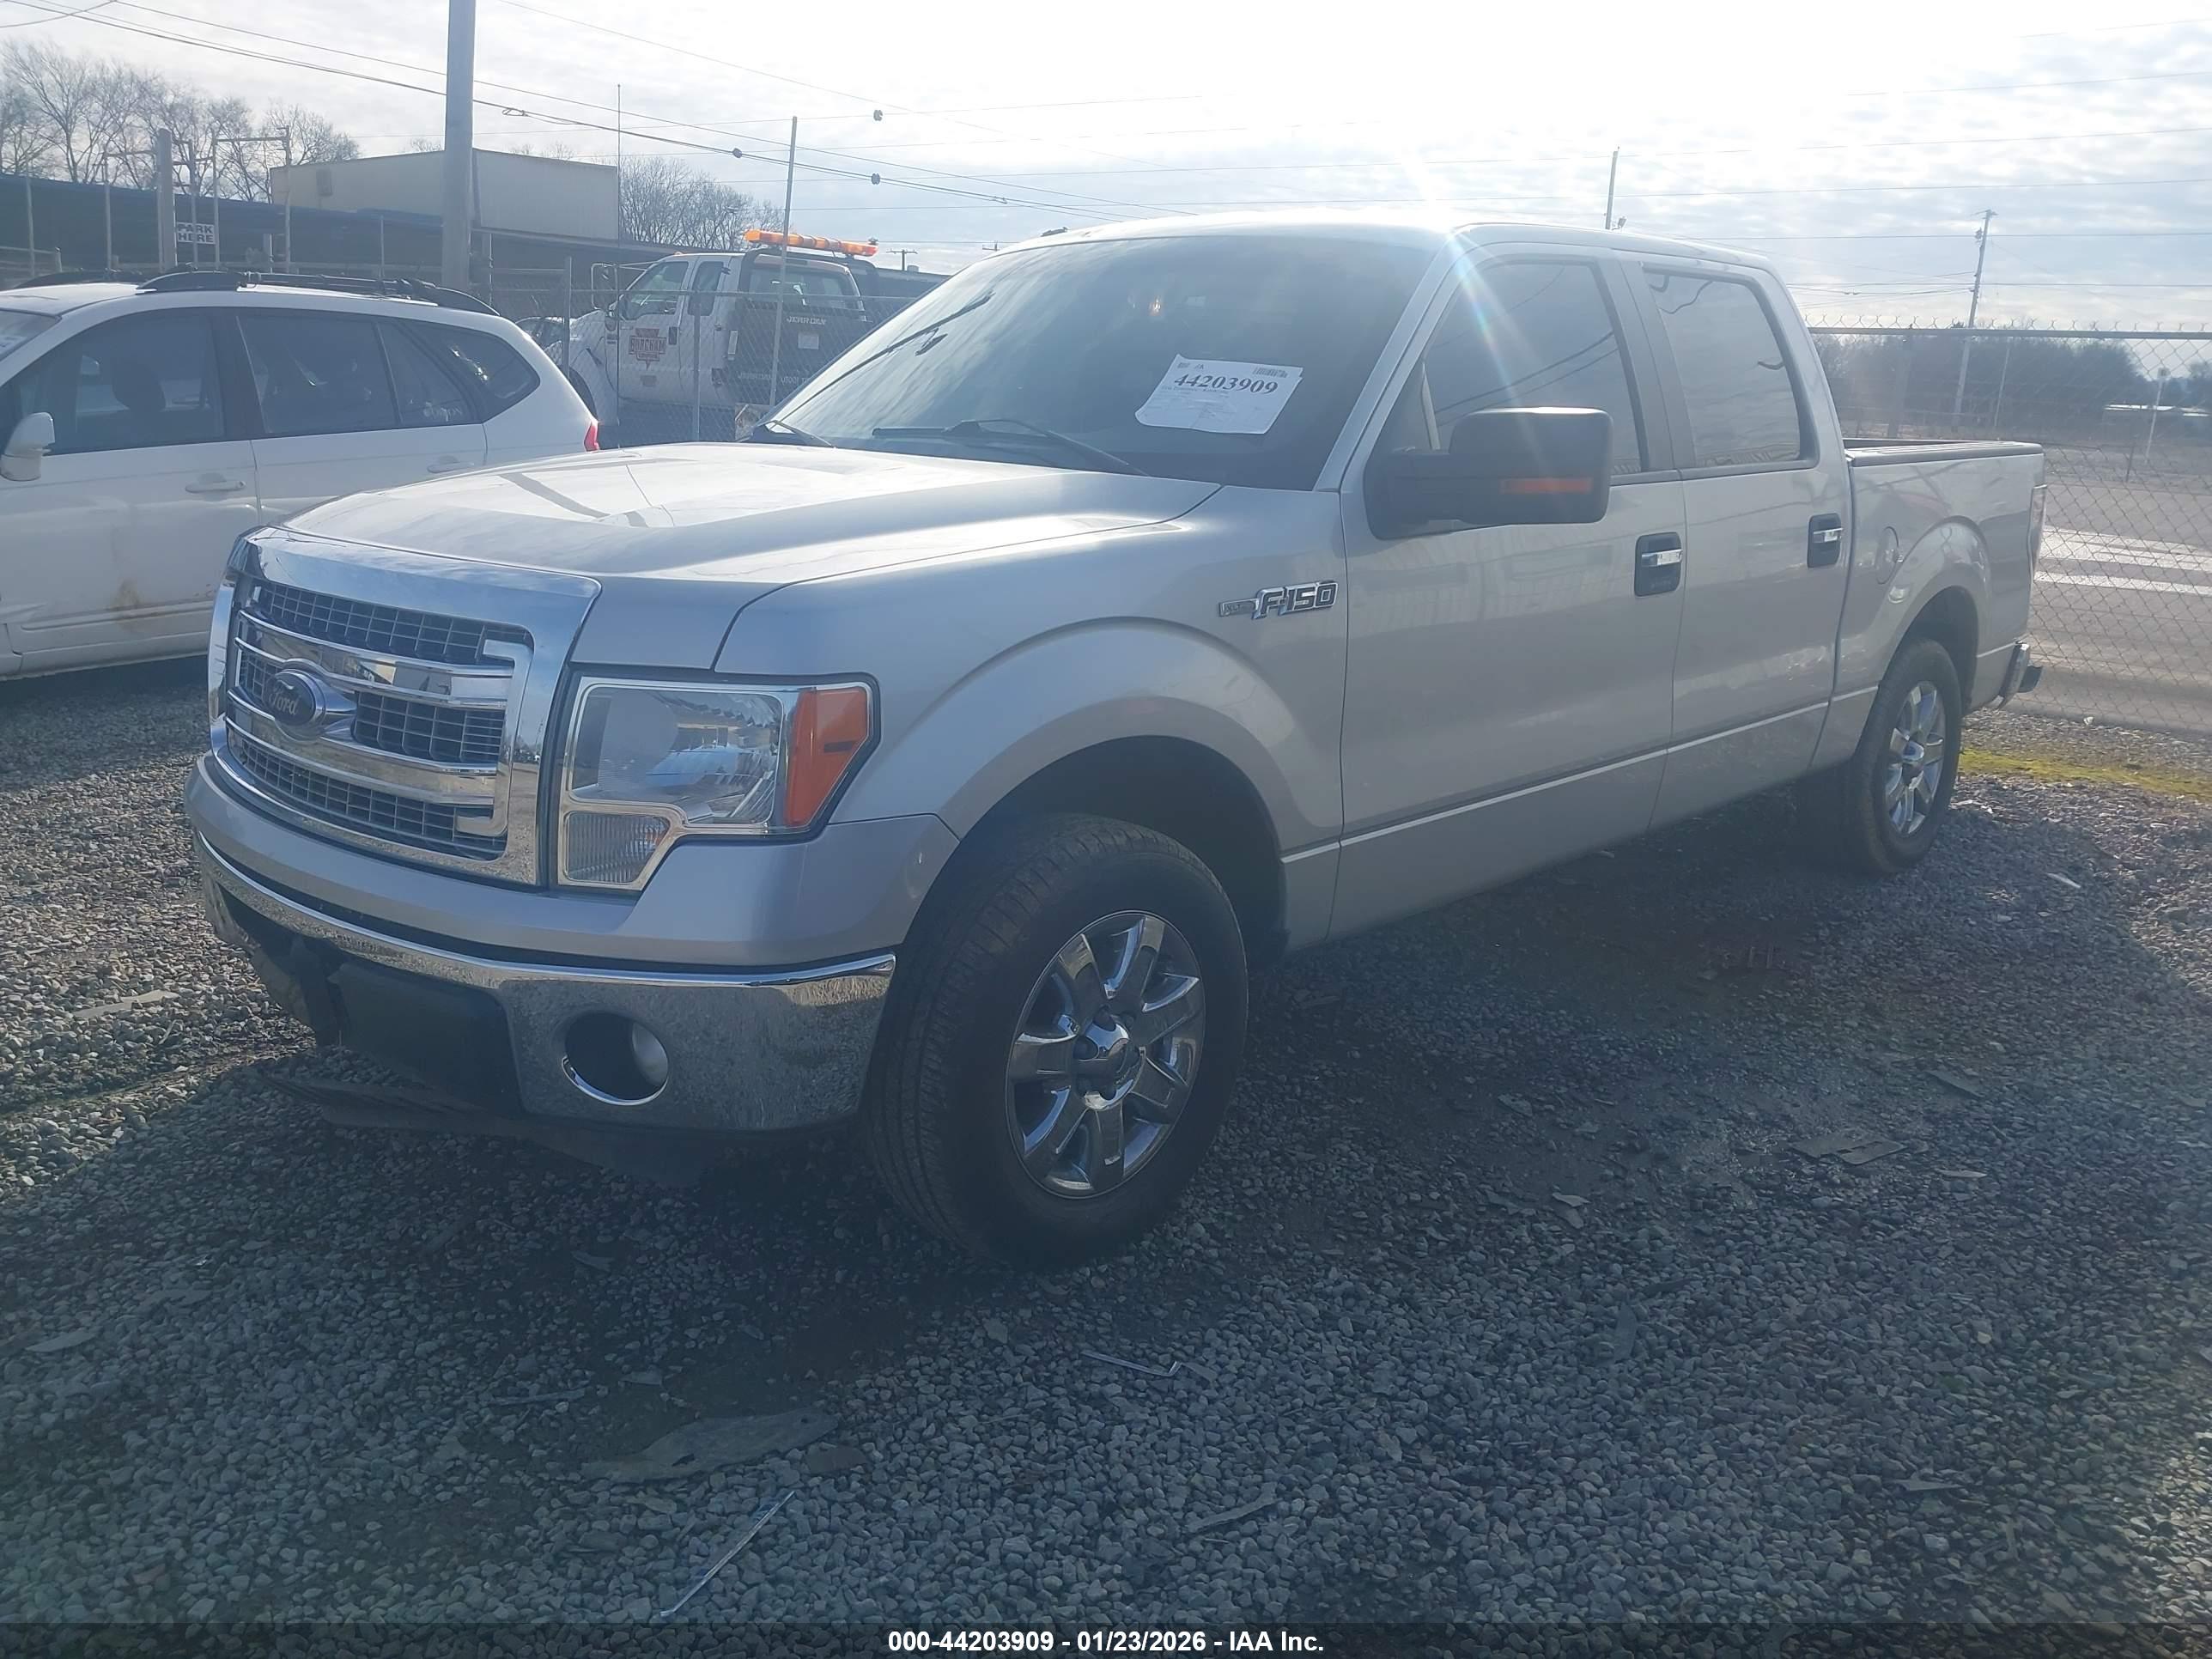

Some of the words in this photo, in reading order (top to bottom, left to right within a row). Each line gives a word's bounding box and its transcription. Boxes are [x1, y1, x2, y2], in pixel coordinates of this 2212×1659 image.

[178, 223, 213, 234] PARK
[178, 233, 214, 242] HERE
[1174, 373, 1279, 395] 44203909
[268, 688, 302, 715] Ford
